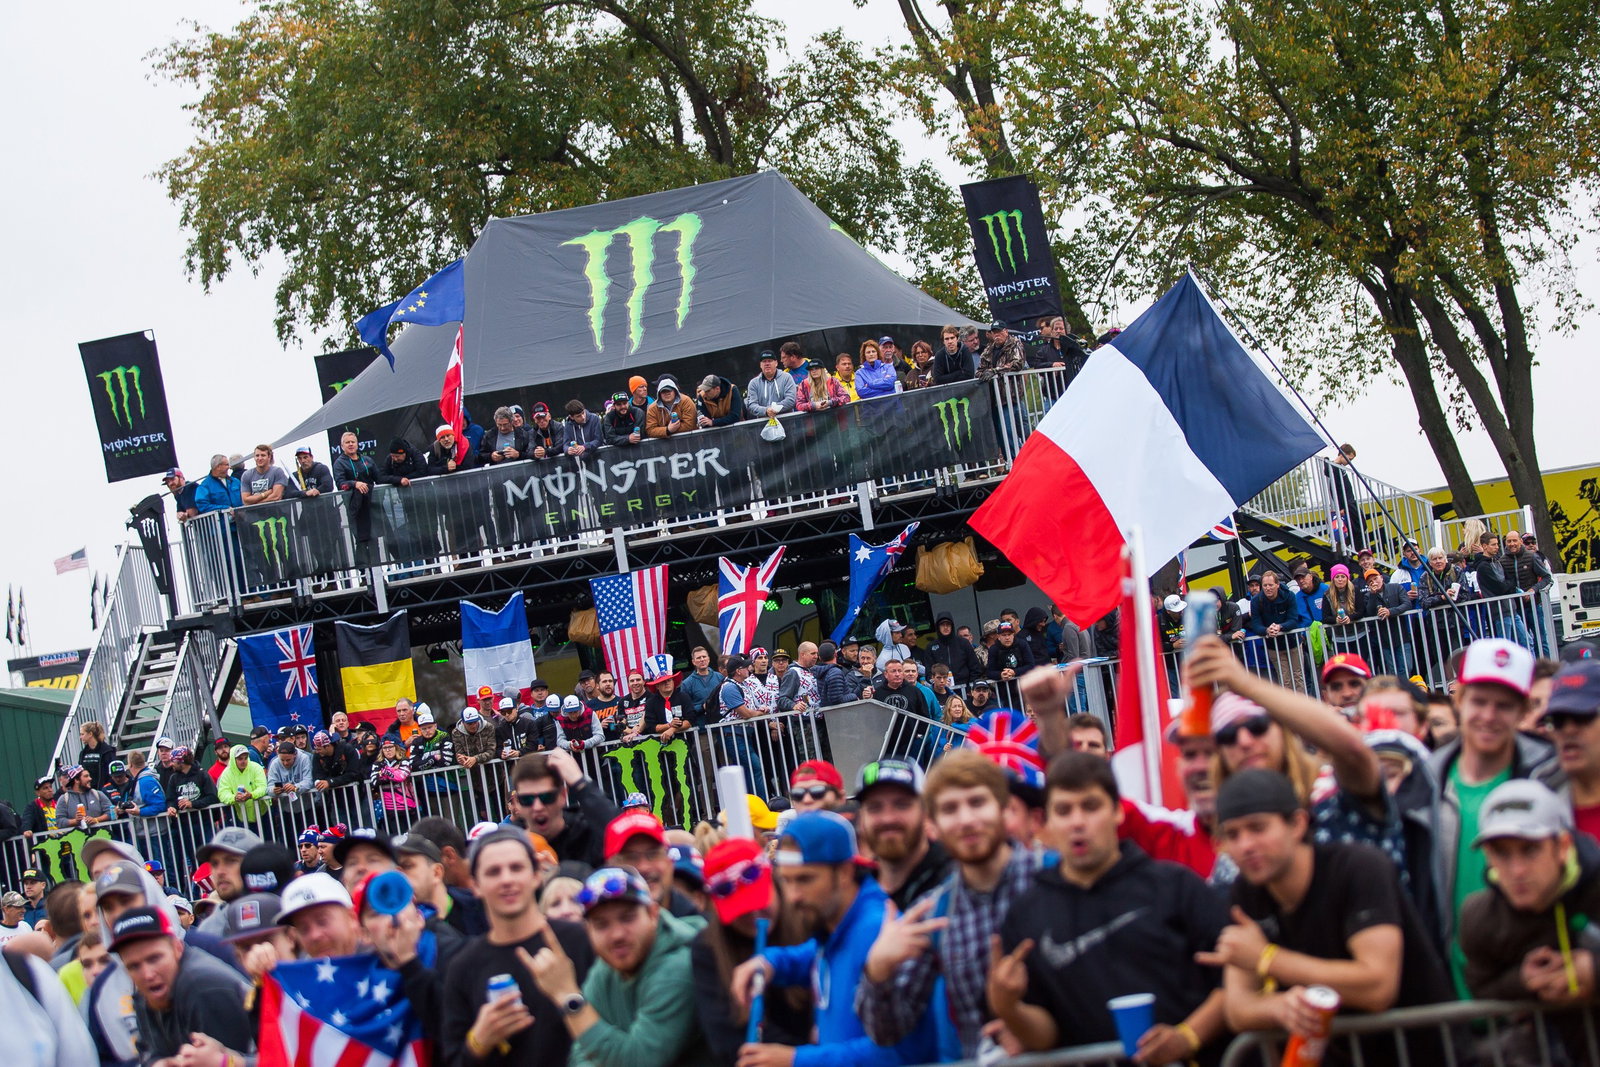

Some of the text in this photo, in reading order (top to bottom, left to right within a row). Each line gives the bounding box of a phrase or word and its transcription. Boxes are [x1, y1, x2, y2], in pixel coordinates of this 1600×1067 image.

[988, 277, 1051, 296] MONSTER
[998, 289, 1044, 303] ENERGY
[103, 432, 167, 452] MONSTER
[115, 445, 160, 458] ENERGY
[503, 448, 730, 507] MONSTER
[545, 490, 697, 525] ENERGY
[245, 871, 278, 888] USA
